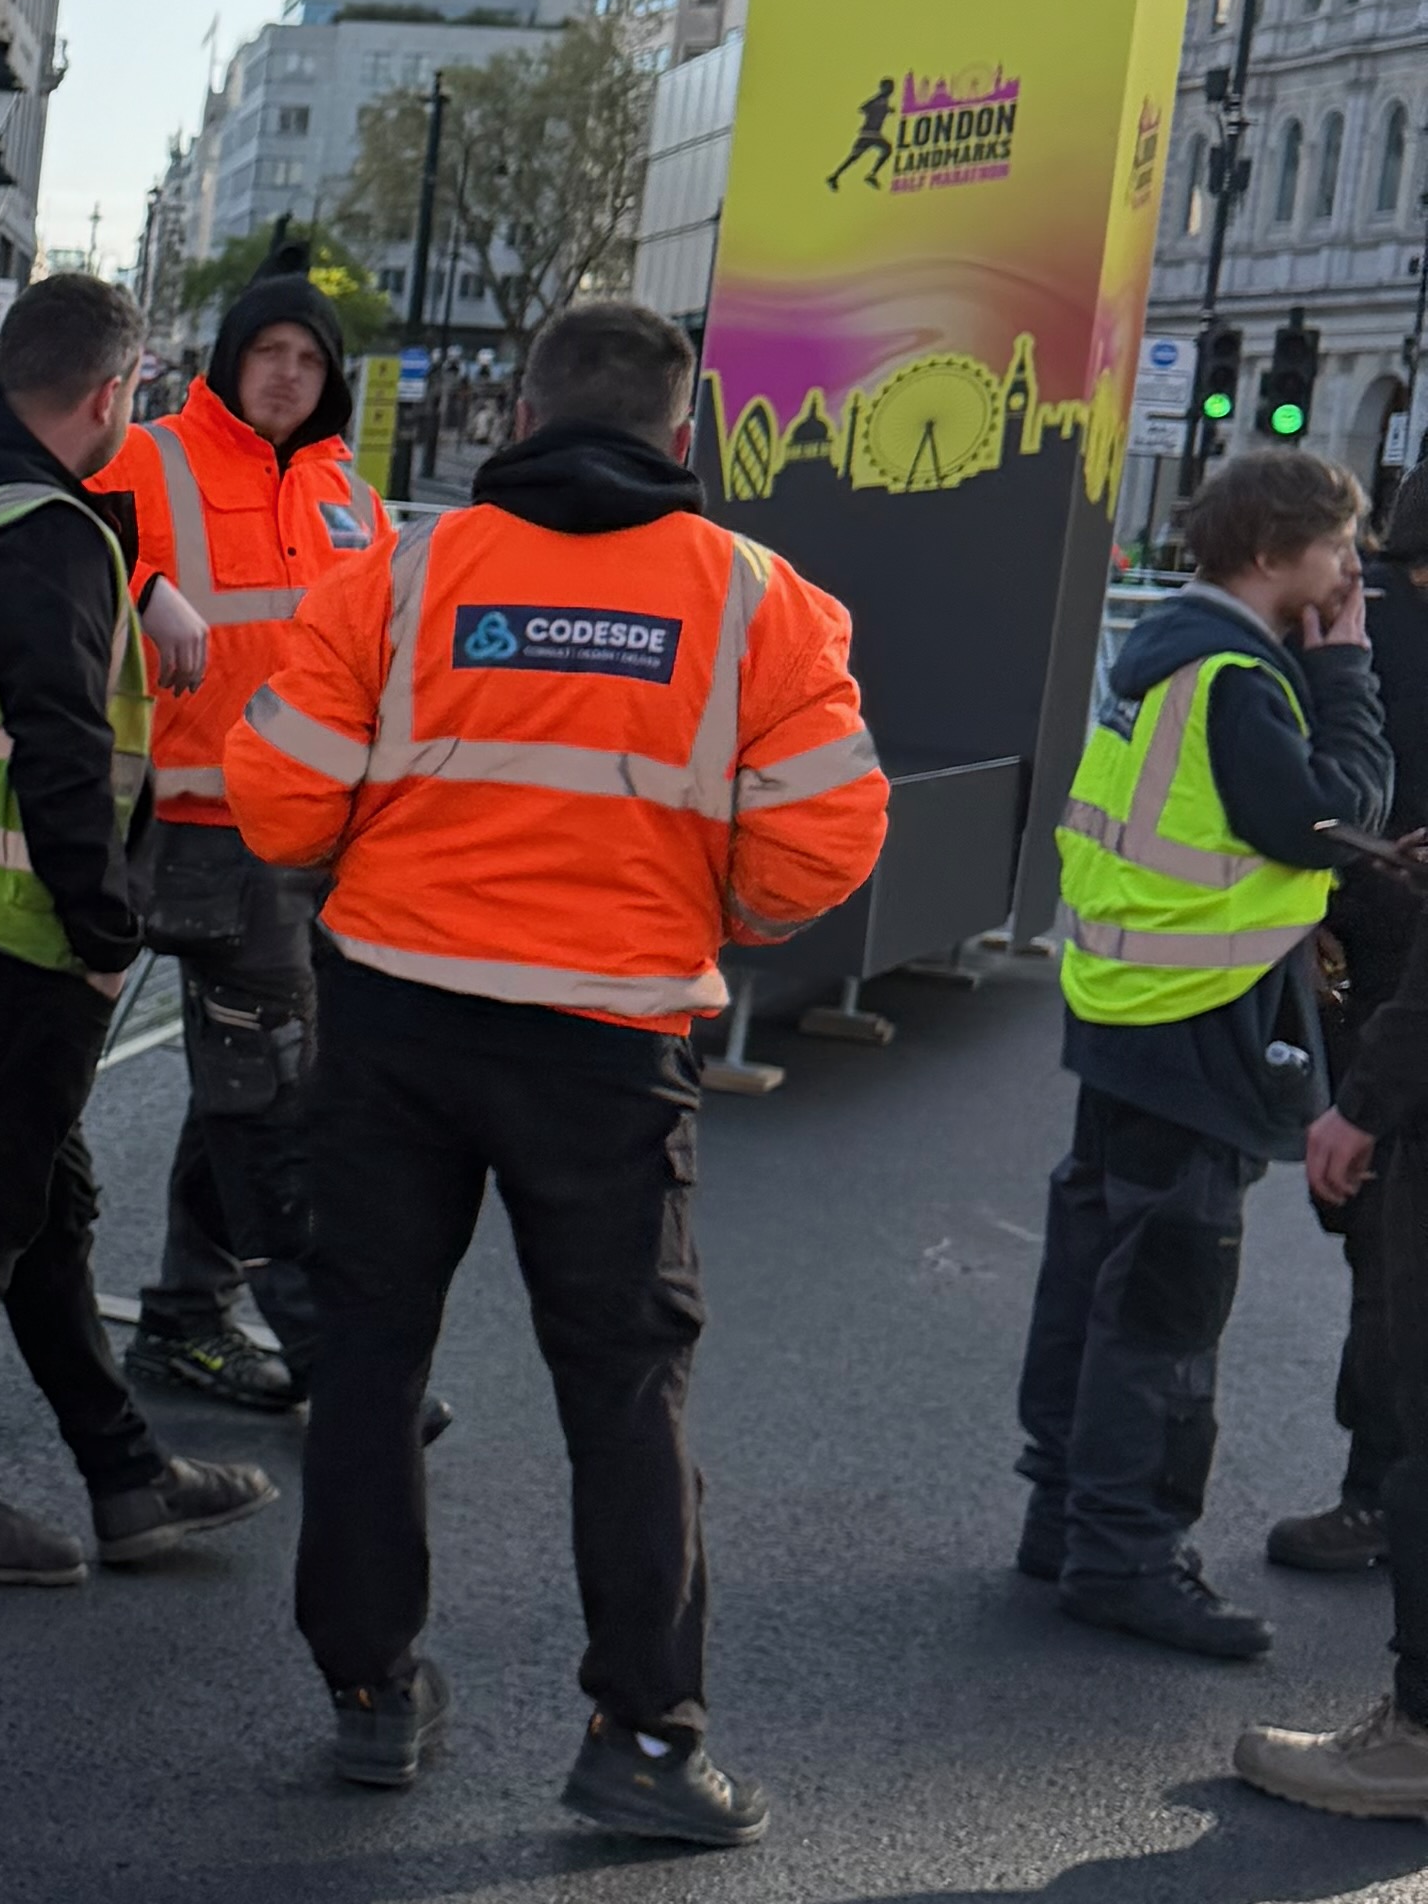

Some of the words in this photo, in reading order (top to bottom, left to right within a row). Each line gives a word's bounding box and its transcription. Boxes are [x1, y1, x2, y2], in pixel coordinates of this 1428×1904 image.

[896, 103, 1017, 149] LONDON
[893, 138, 1012, 174] LANDMARKS
[525, 617, 667, 654] CODESDE
